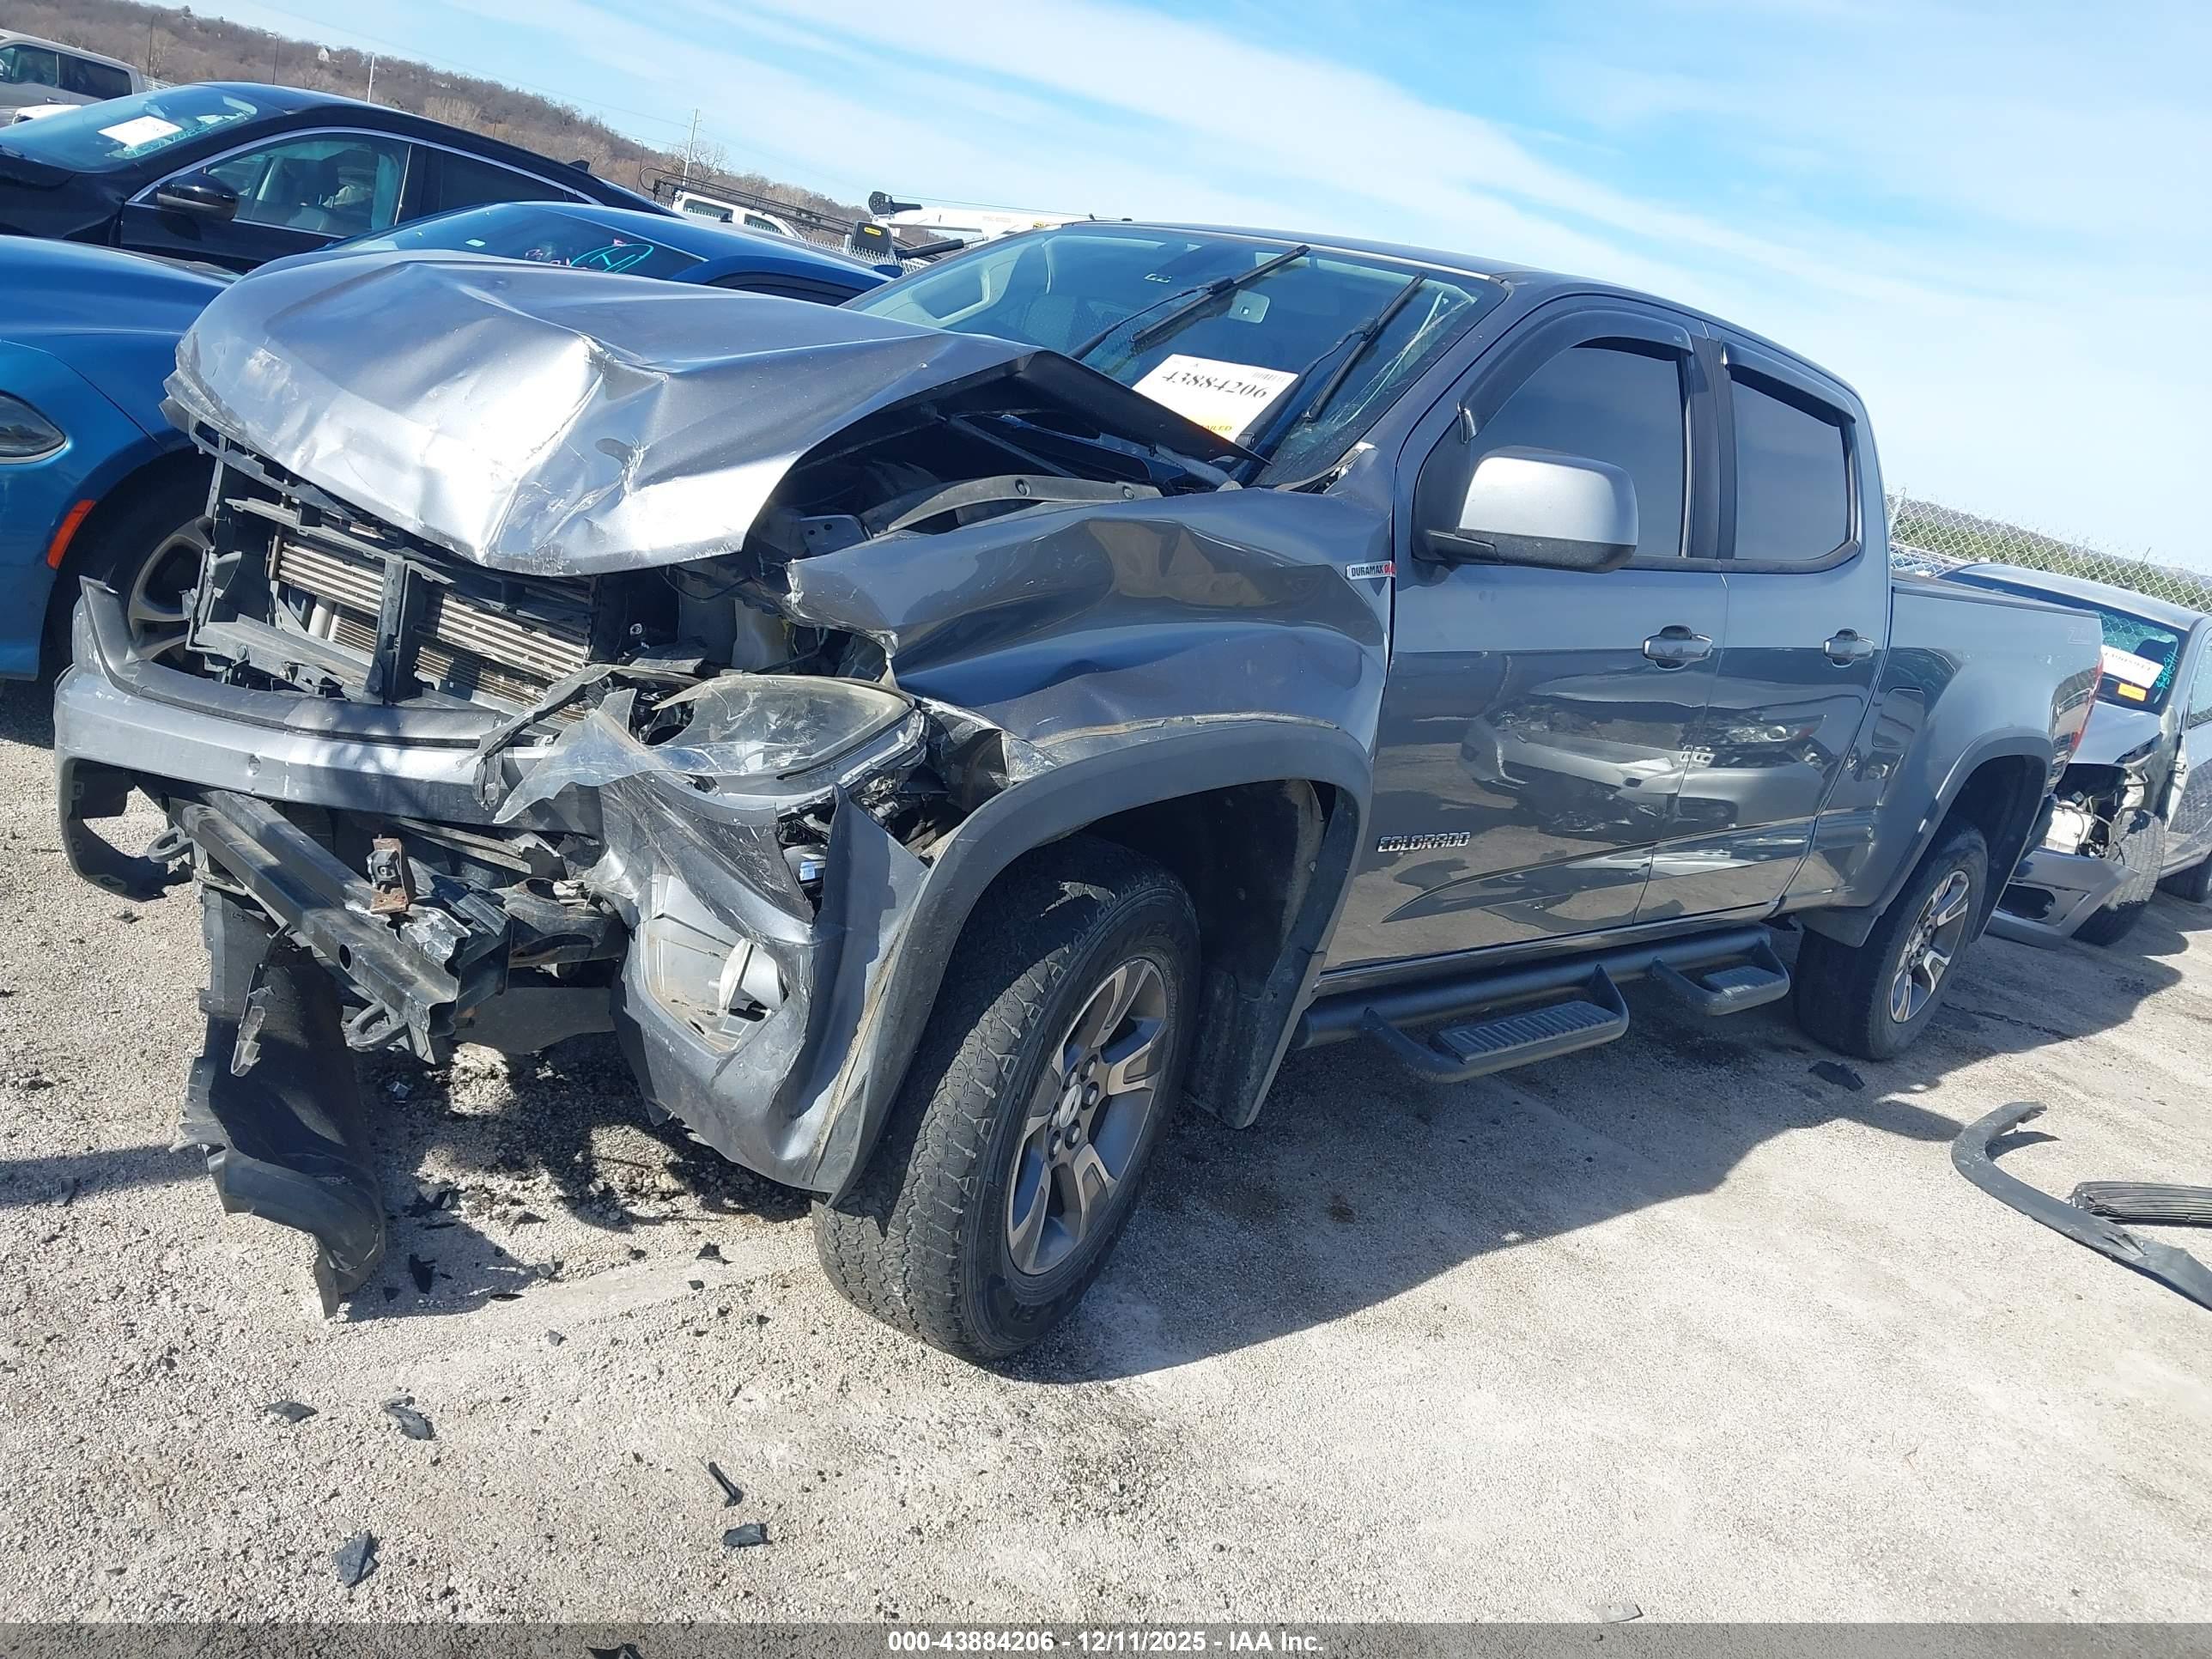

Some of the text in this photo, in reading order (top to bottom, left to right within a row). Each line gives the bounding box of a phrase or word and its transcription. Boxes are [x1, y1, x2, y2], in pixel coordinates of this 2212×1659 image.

[1162, 370, 1269, 398] 43884206
[1351, 565, 1383, 577] DURAMAX
[1377, 831, 1471, 853] COLORADO
